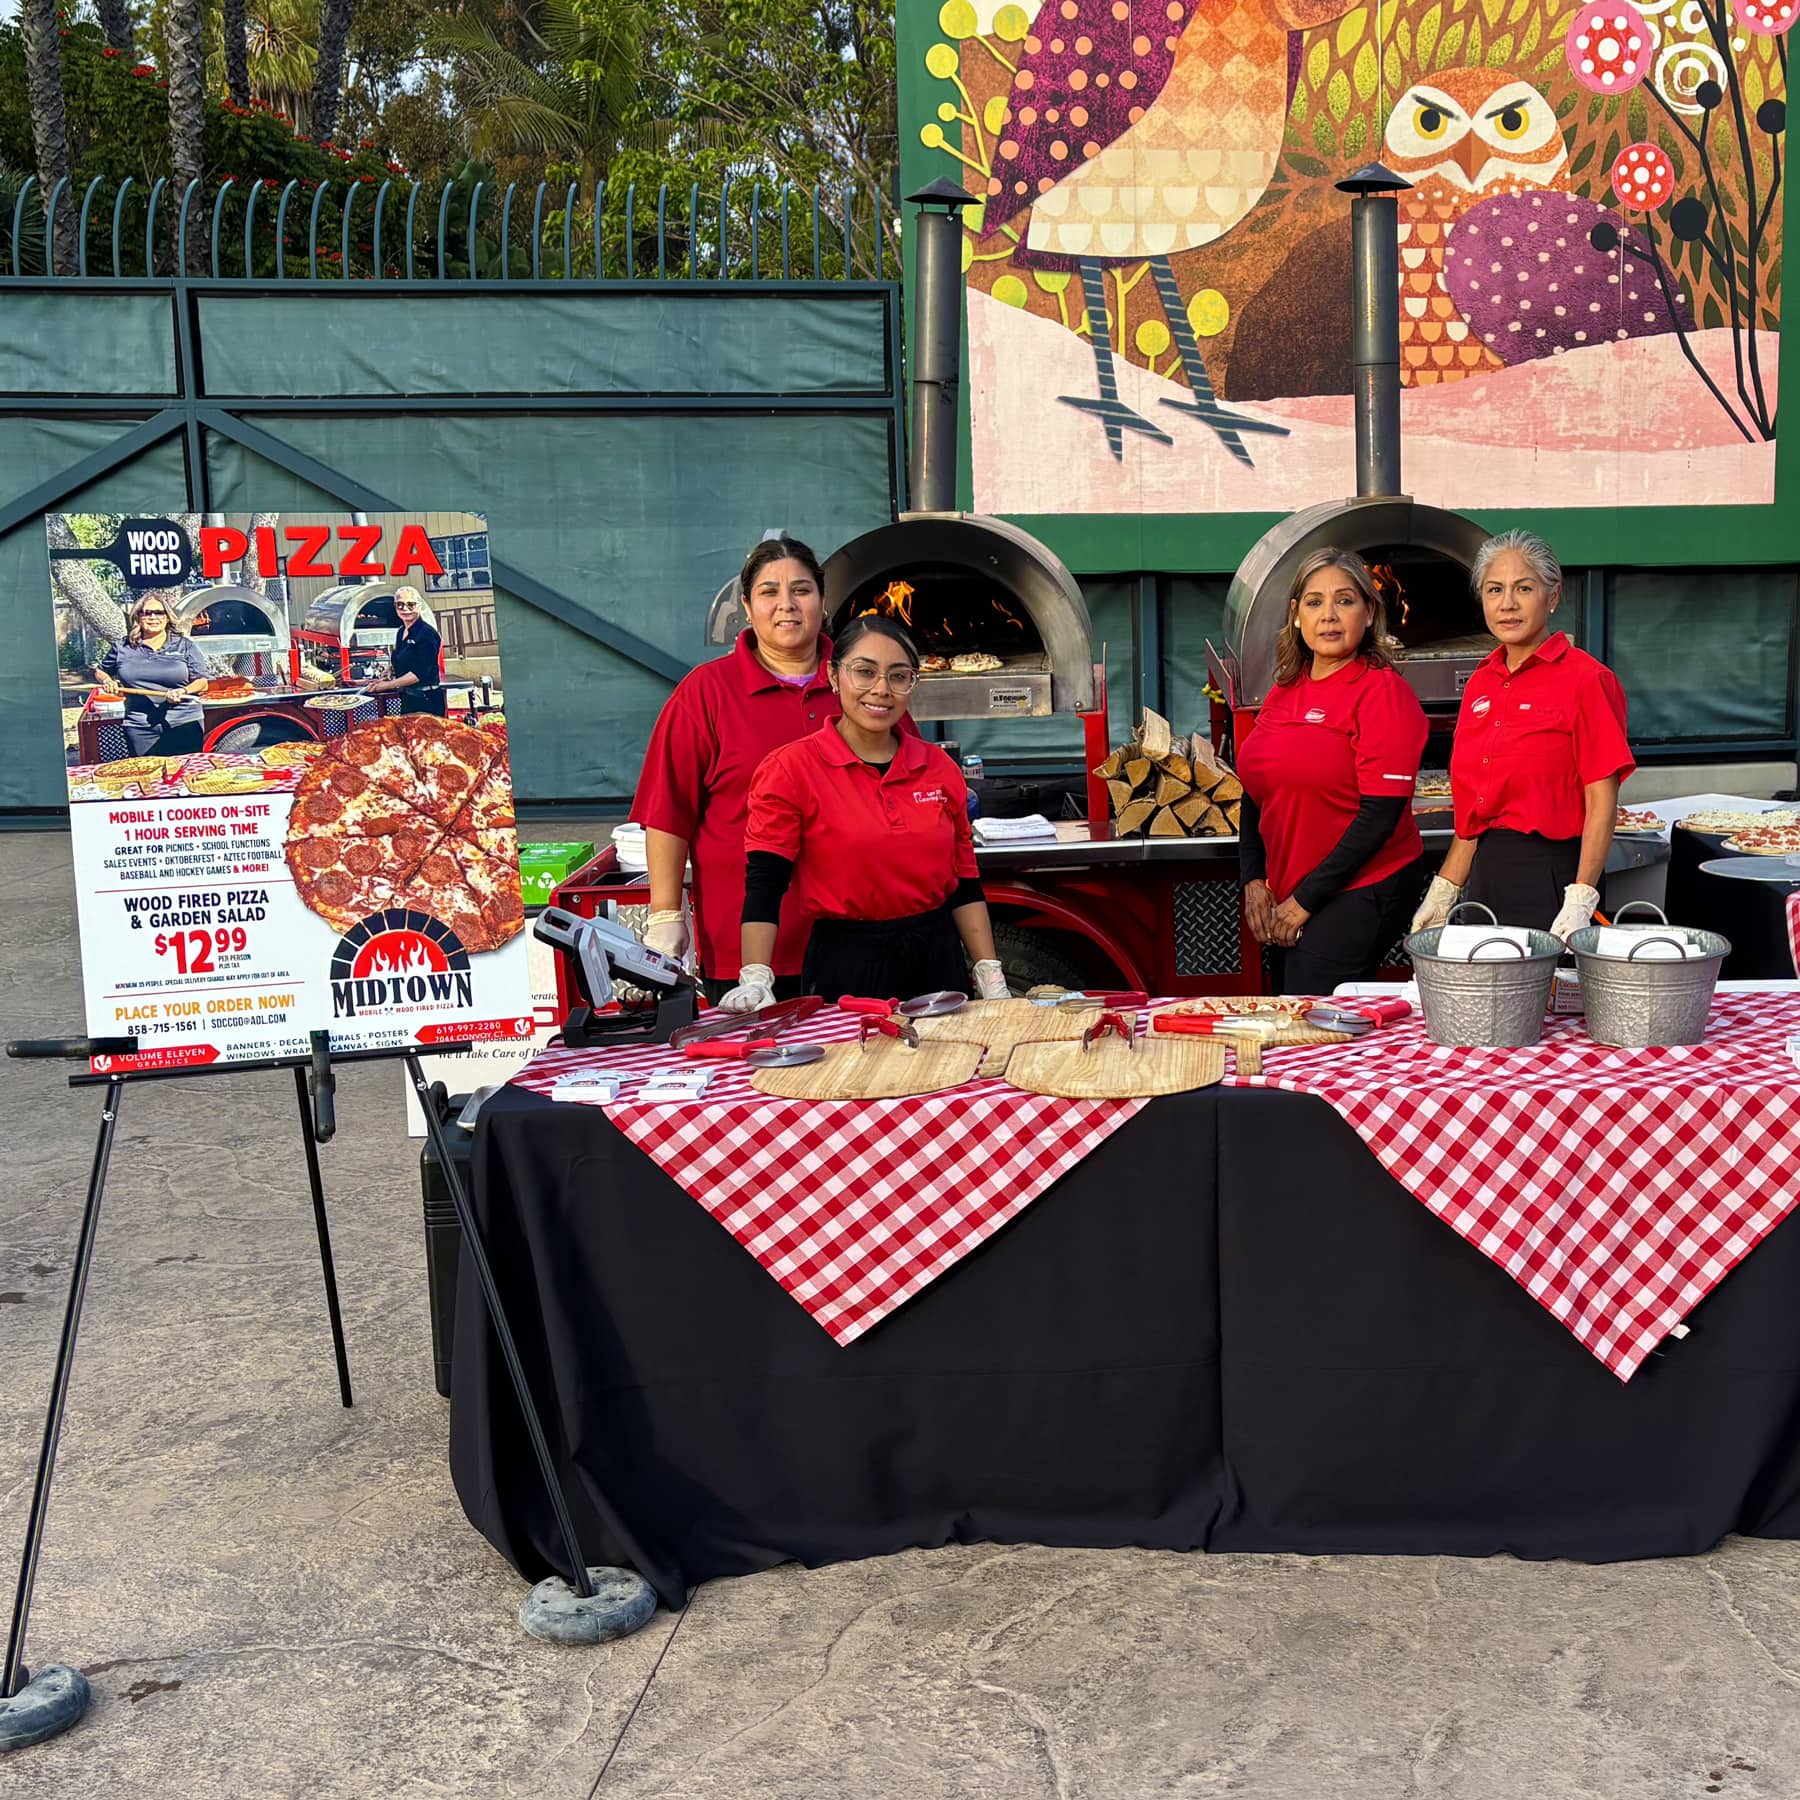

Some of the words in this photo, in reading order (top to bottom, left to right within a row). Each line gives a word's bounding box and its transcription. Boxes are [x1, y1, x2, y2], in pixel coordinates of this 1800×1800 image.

[126, 529, 180, 551] WOOD
[199, 524, 445, 578] PIZZA
[129, 552, 182, 576] FIRED
[109, 810, 154, 824] MOBILE
[167, 806, 216, 821] COOKED
[221, 804, 270, 818] ON-SITE
[124, 830, 131, 841] 1
[135, 827, 170, 841] HOUR
[174, 824, 226, 839] SERVING
[230, 822, 258, 836] TIME
[114, 845, 143, 856] GREAT
[146, 844, 164, 854] FOR
[165, 843, 194, 853] PICNICS
[202, 840, 230, 851] SCHOOL
[231, 838, 271, 849] FUNCTIONS
[103, 858, 127, 869] SALES
[128, 857, 157, 868] EVENTS
[165, 854, 215, 865] OKTOBERFEST
[223, 852, 246, 862] AZTEC
[247, 850, 282, 860] FOOTBALL
[120, 869, 157, 880] BASEBALL
[159, 868, 174, 878] AND
[176, 866, 204, 877] HOCKEY
[206, 865, 231, 875] GAMES
[233, 864, 239, 874] &
[241, 863, 269, 873] MORE!
[123, 895, 172, 913] WOOD
[178, 892, 221, 909] FIRED
[226, 889, 270, 905] PIZZA
[131, 914, 142, 930] &
[149, 910, 212, 928] GARDEN
[217, 906, 266, 924] SALAD
[218, 954, 229, 962] PER
[230, 953, 252, 961] PERSON
[330, 971, 473, 1018] MIDTOWN
[115, 1004, 158, 1021] PLACE
[163, 1000, 201, 1017] YOUR
[206, 997, 253, 1014] ORDER
[258, 993, 296, 1010] NOW!
[358, 1008, 383, 1016] MOBILE
[395, 1006, 414, 1014] WOOD
[416, 1004, 435, 1012] FIRED
[436, 1002, 455, 1010] PIZZA
[127, 1020, 197, 1035] 858-715-1561
[211, 1013, 287, 1029] SDCCGO@AOL.COM
[436, 1022, 502, 1034] 619-997-2280
[226, 1041, 271, 1051] BANNERS
[279, 1037, 309, 1048] DECAL
[368, 1029, 409, 1039] POSTERS
[226, 1049, 275, 1060] WINDOWS
[284, 1047, 311, 1055] WRAP
[330, 1042, 368, 1052] CANVAS
[375, 1039, 404, 1048] SIGNS
[118, 1051, 164, 1062] VOLUME
[166, 1048, 206, 1058] ELEVEN
[137, 1057, 189, 1069] GRAPHICS
[496, 1048, 516, 1058] Care
[518, 1048, 528, 1060] of
